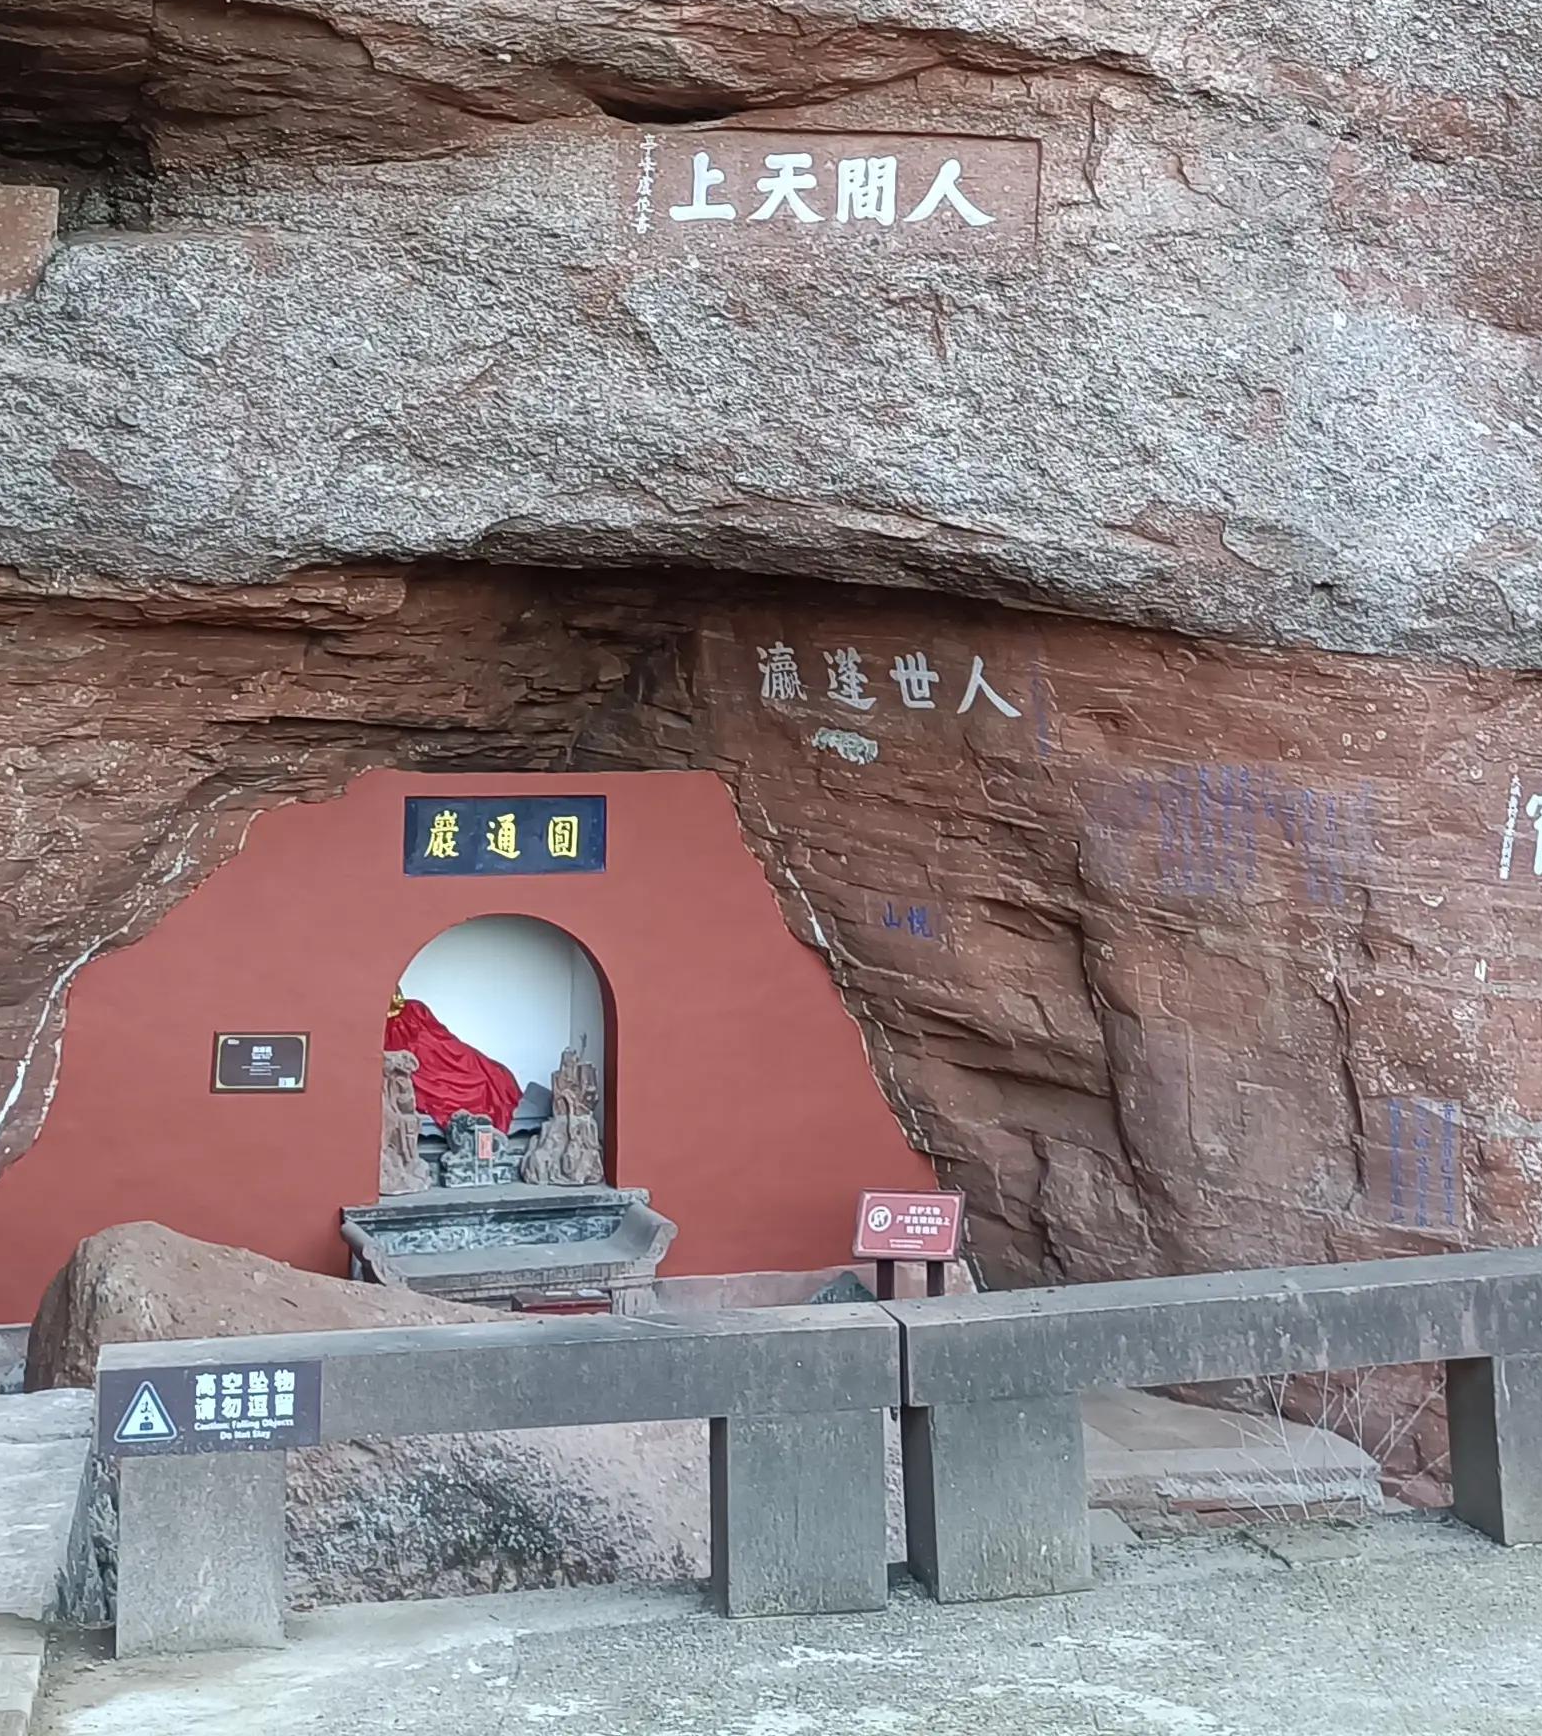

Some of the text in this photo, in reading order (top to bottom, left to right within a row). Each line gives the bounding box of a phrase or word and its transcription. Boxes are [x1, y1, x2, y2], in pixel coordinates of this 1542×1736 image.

[195, 1369, 296, 1397] 高空坠物
[194, 1393, 295, 1421] 请勿逗留
